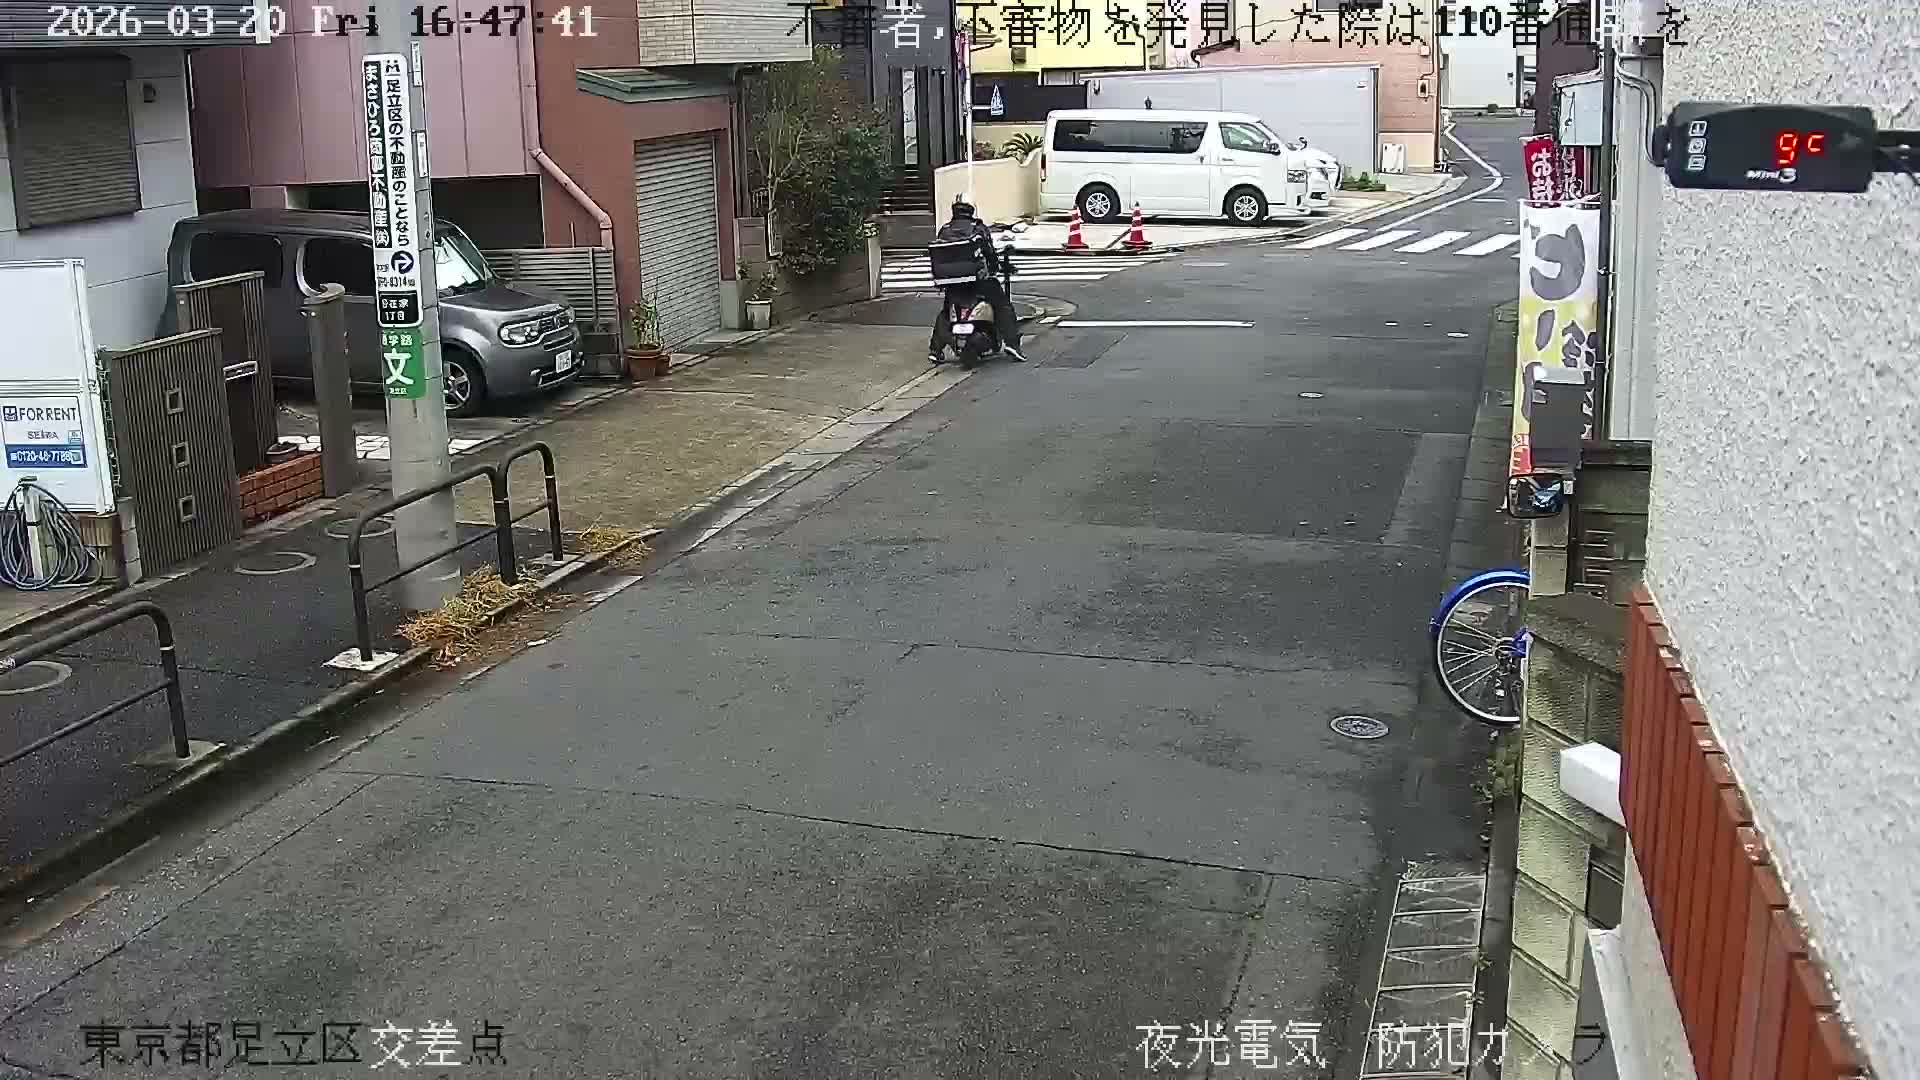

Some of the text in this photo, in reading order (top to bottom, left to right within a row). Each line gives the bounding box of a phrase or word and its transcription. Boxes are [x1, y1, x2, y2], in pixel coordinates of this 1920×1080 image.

[383, 347, 415, 385] 文
[19, 407, 76, 421] FOR RENT
